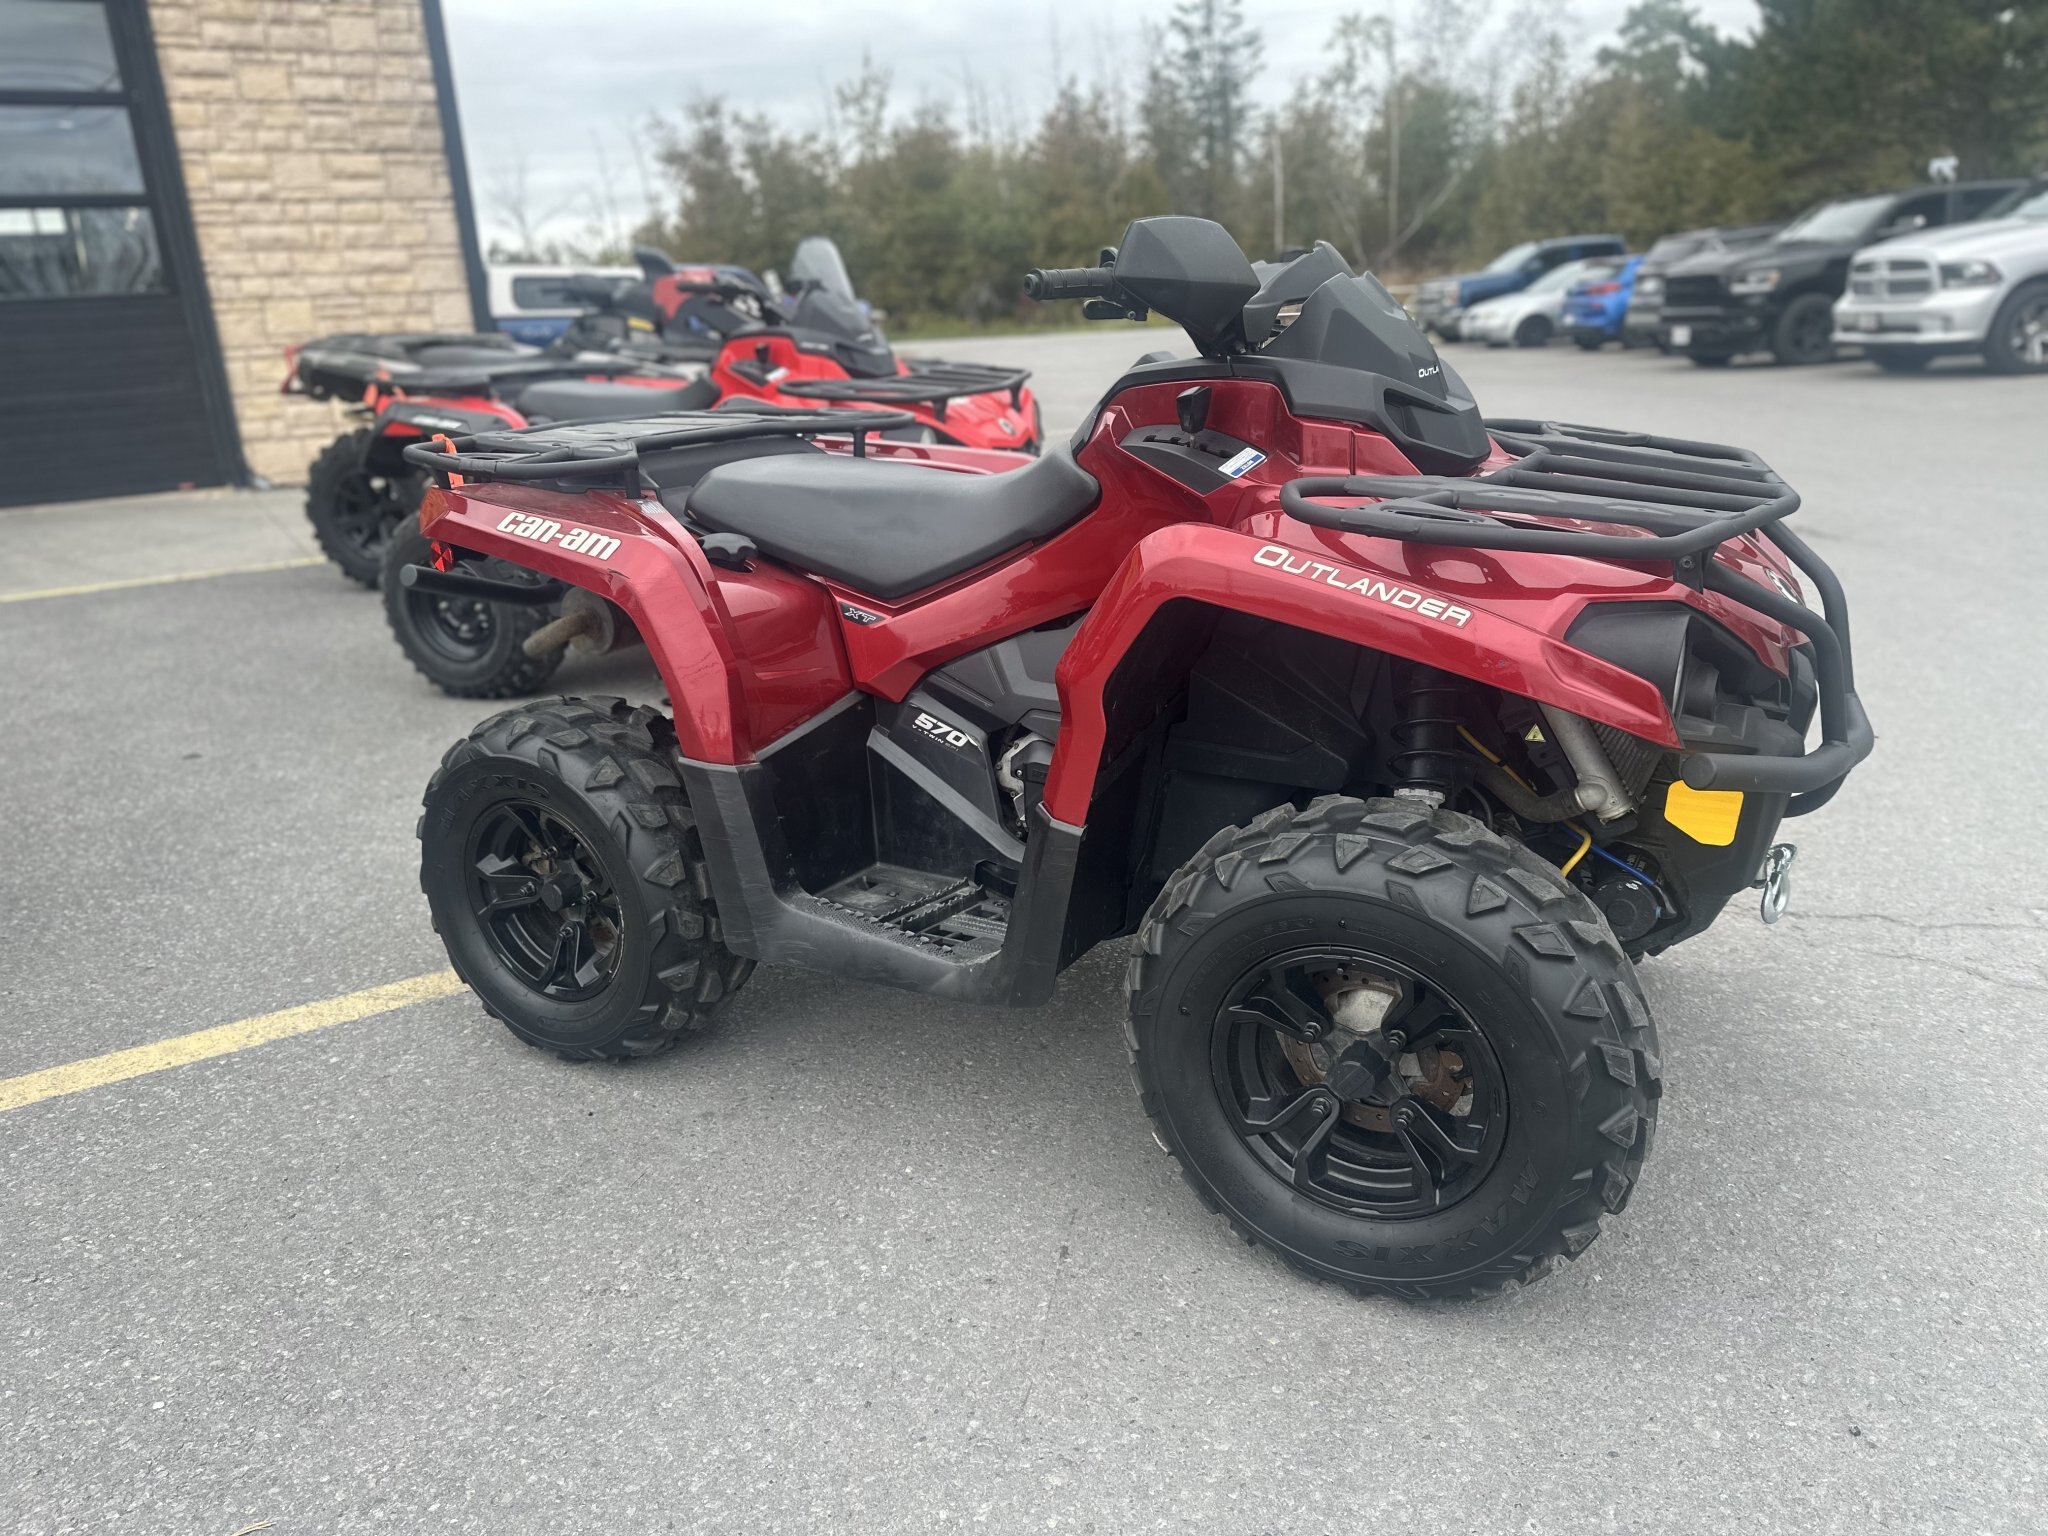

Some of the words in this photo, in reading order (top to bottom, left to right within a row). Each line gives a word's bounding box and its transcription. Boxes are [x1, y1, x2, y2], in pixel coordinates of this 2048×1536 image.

[496, 511, 622, 561] can-am
[1253, 545, 1472, 627] OUTLANDER
[843, 607, 876, 623] XT
[914, 712, 968, 747] 570
[1330, 1157, 1541, 1264] MAXXIS
